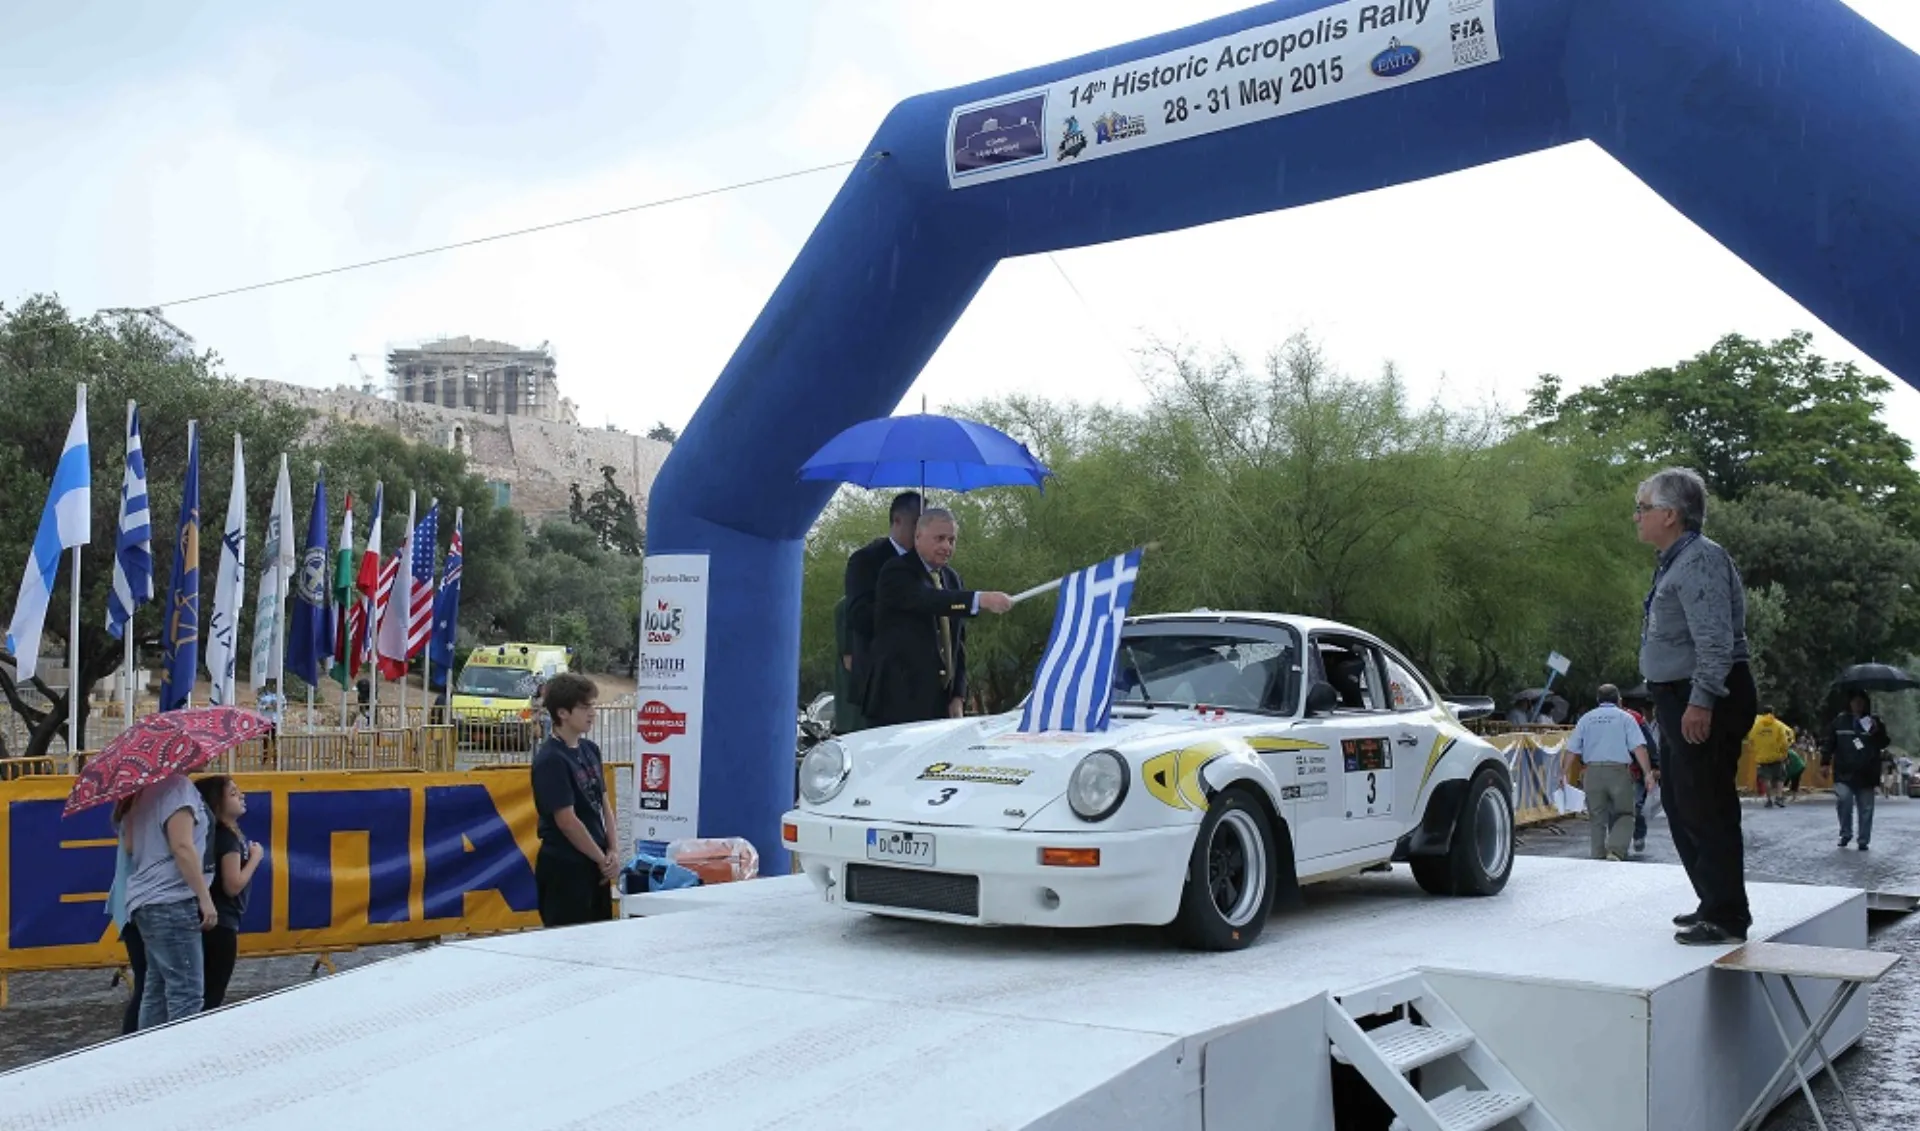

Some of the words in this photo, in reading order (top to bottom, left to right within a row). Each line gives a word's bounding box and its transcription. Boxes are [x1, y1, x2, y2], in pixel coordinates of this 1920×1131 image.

[1069, 79, 1107, 109] 14th
[1111, 55, 1210, 100] Historic
[1217, 20, 1349, 72] Acropolis
[1358, 0, 1430, 33] Rally
[1164, 97, 1188, 126] 28
[1208, 86, 1232, 116] 31
[1239, 75, 1285, 108] May
[1290, 55, 1344, 96] 2015
[928, 787, 958, 806] 3
[1367, 772, 1376, 804] 3
[9, 784, 540, 949] ΕΠΑ
